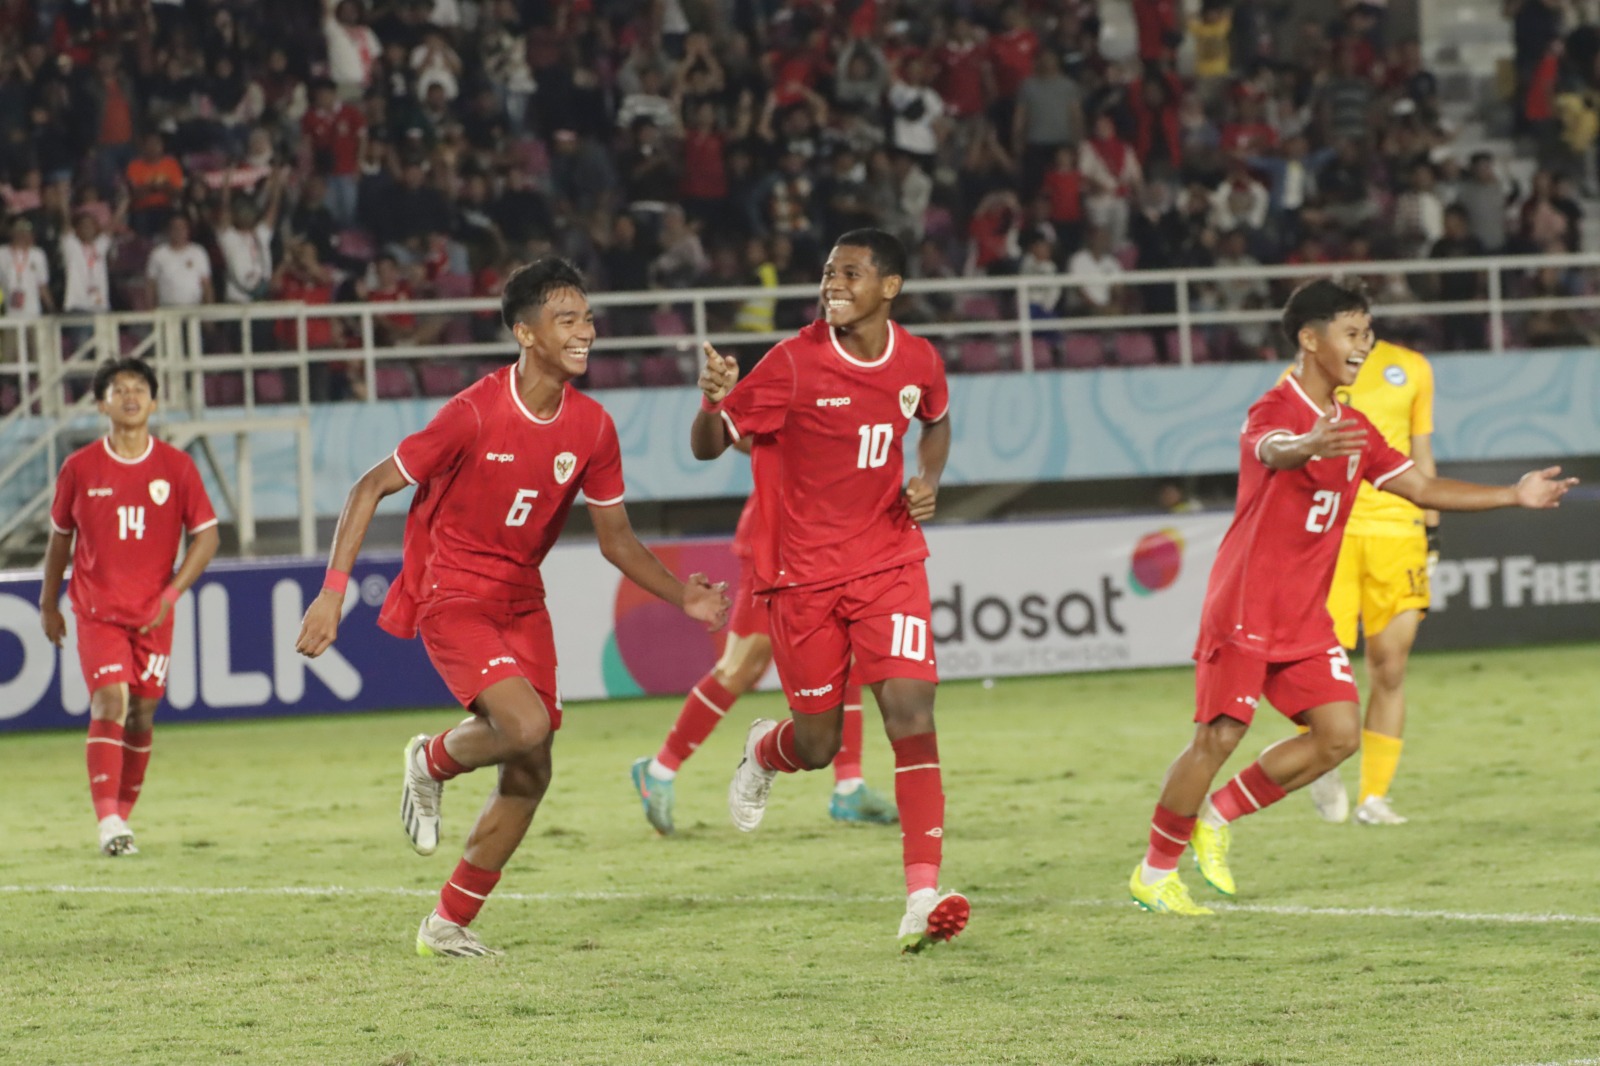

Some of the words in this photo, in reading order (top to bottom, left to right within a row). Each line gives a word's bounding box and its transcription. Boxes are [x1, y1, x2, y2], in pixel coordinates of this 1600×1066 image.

[816, 396, 851, 408] erspo
[857, 423, 893, 469] 10
[117, 505, 146, 540] 14
[505, 488, 539, 527] 6
[1304, 489, 1341, 533] 21
[890, 613, 927, 661] 10
[140, 653, 170, 687] 14
[800, 683, 833, 697] erspo
